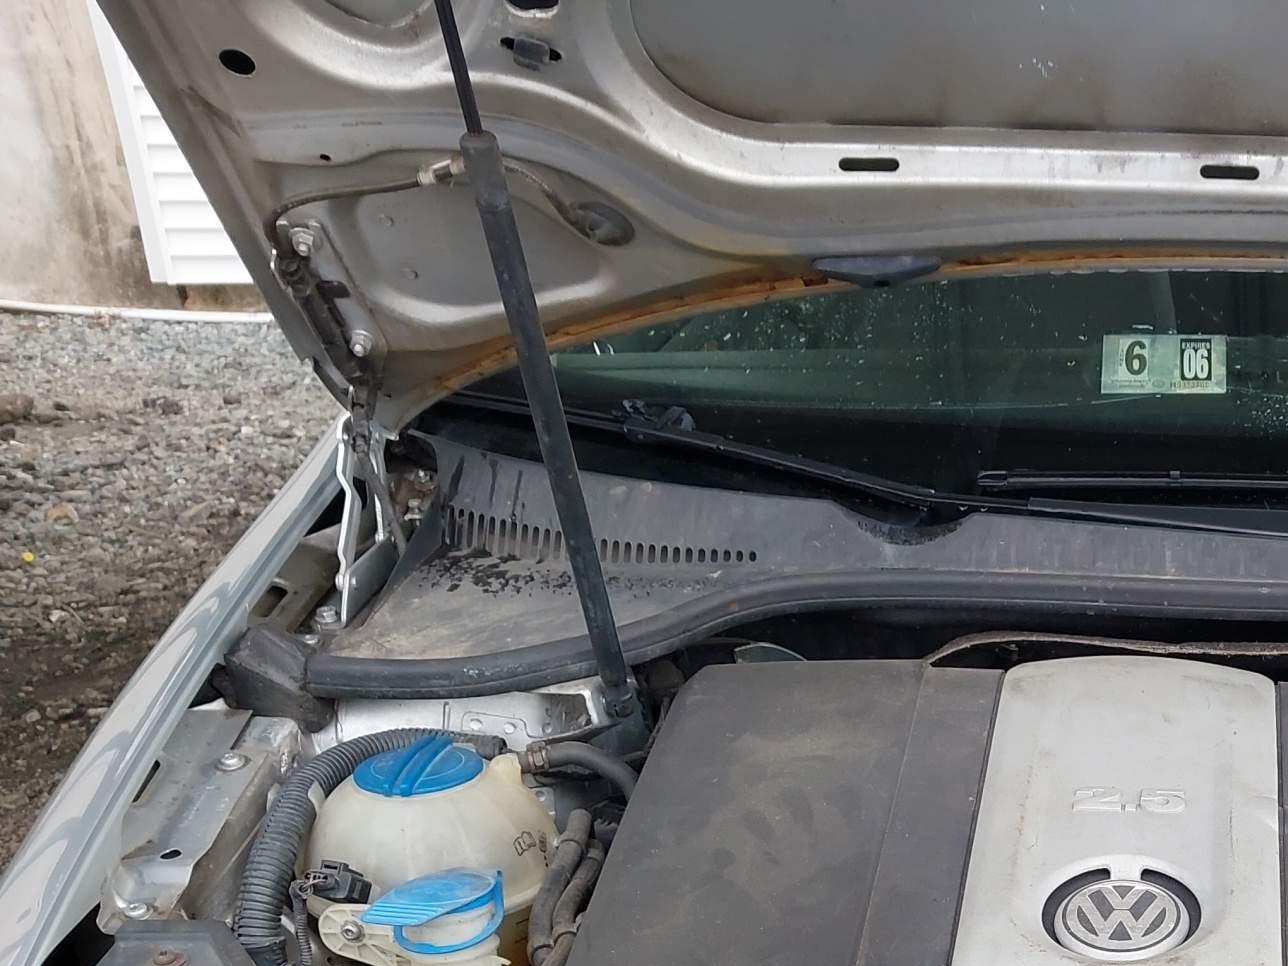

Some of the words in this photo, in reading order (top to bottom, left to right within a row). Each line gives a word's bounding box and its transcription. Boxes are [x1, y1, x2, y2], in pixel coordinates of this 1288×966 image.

[1125, 341, 1147, 376] 6
[1183, 349, 1209, 379] 06
[1072, 787, 1186, 813] 2.5
